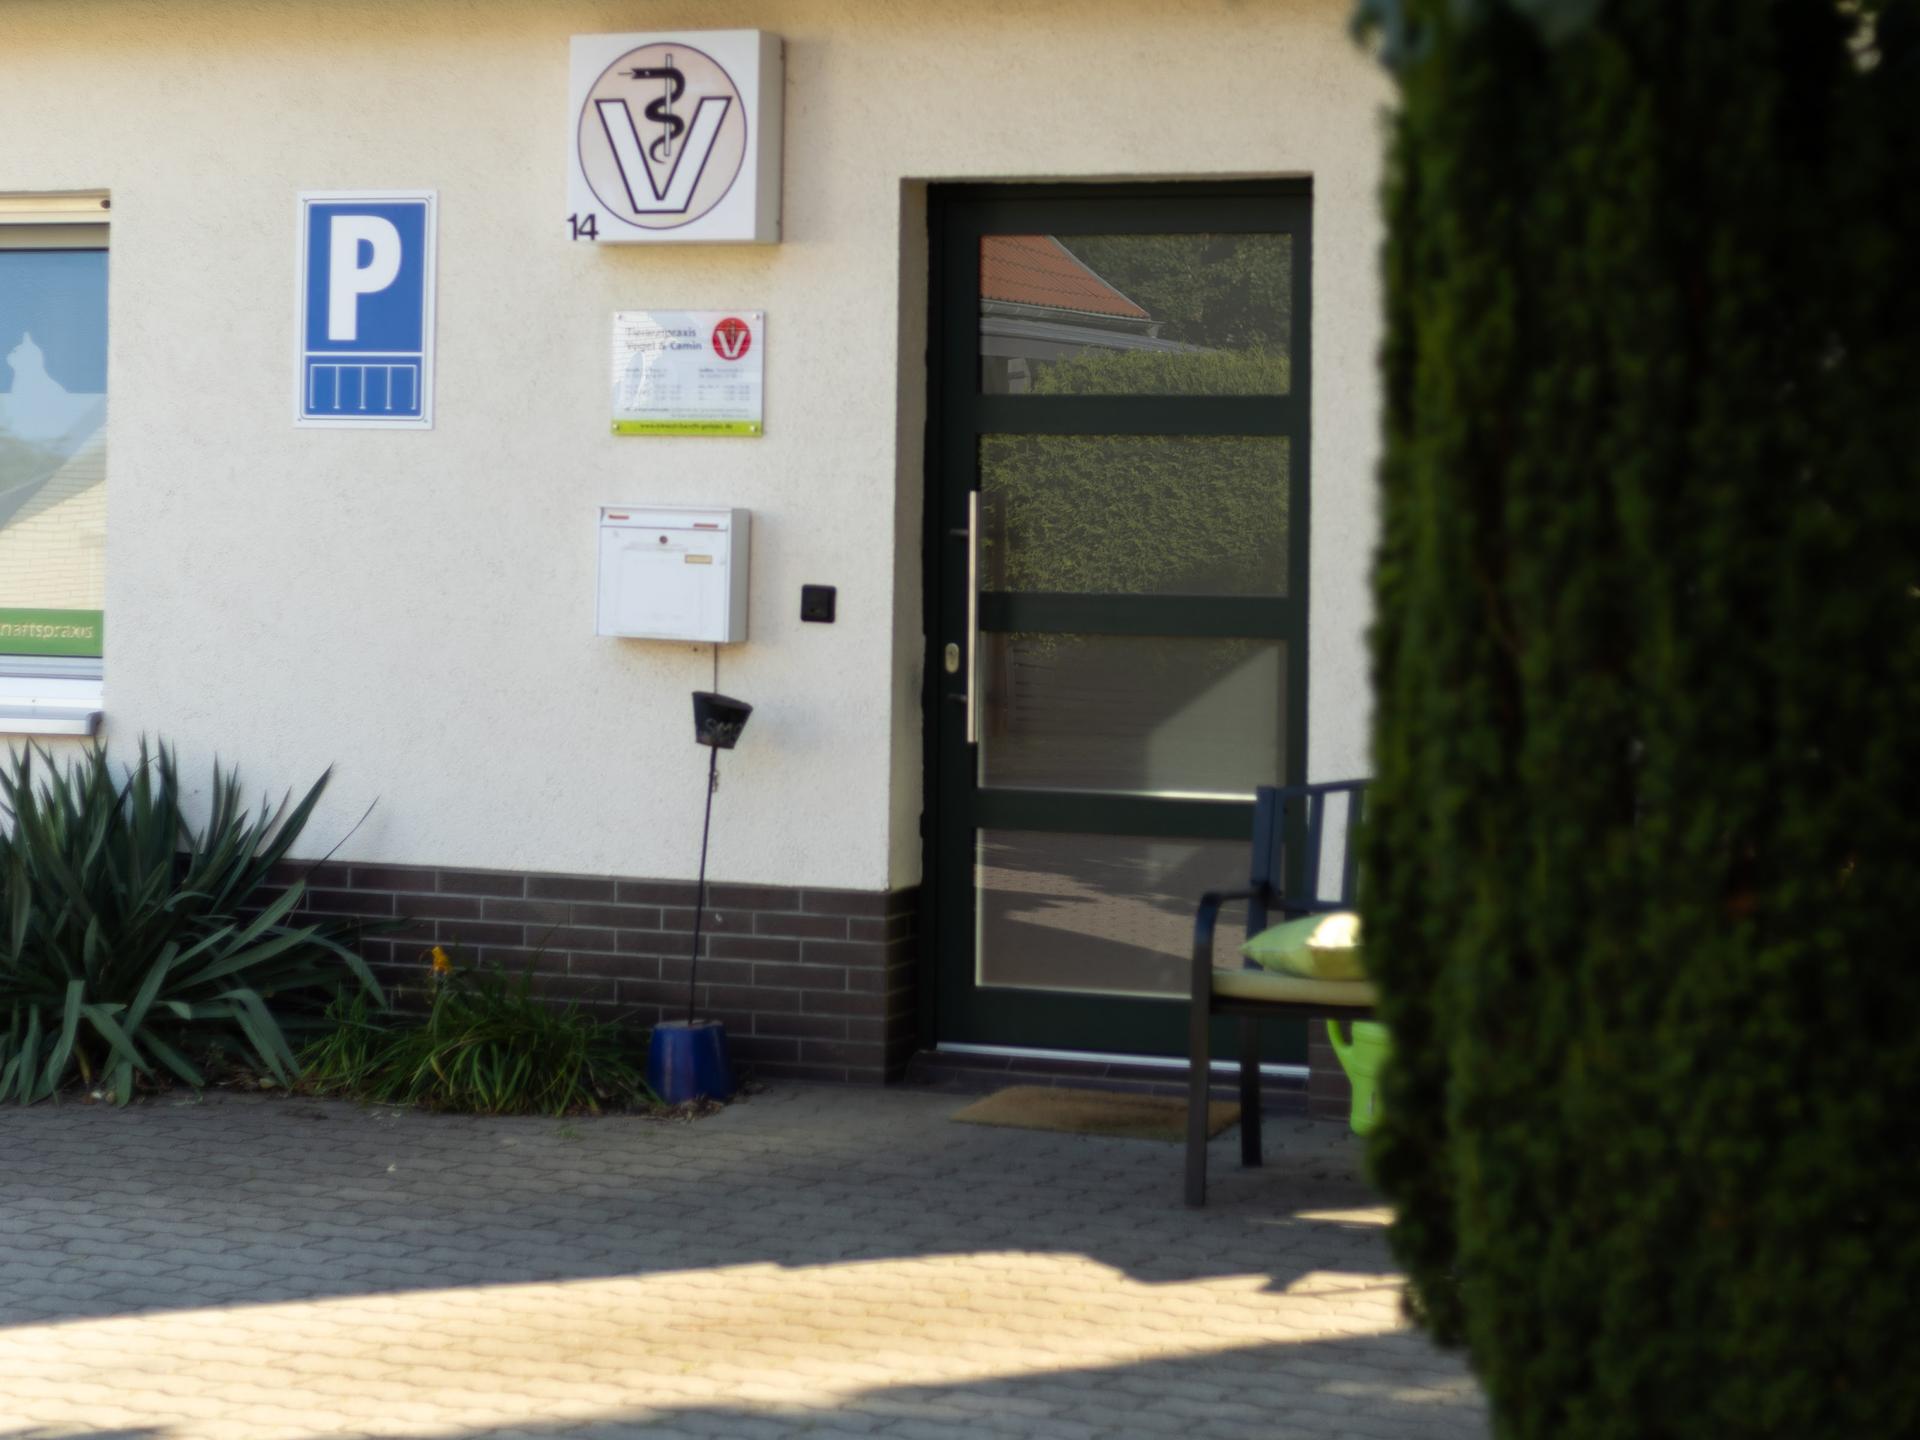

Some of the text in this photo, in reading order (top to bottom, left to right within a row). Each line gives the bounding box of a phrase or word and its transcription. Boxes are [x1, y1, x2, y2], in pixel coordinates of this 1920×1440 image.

[594, 96, 732, 214] V
[328, 215, 402, 341] P
[567, 213, 599, 241] 14
